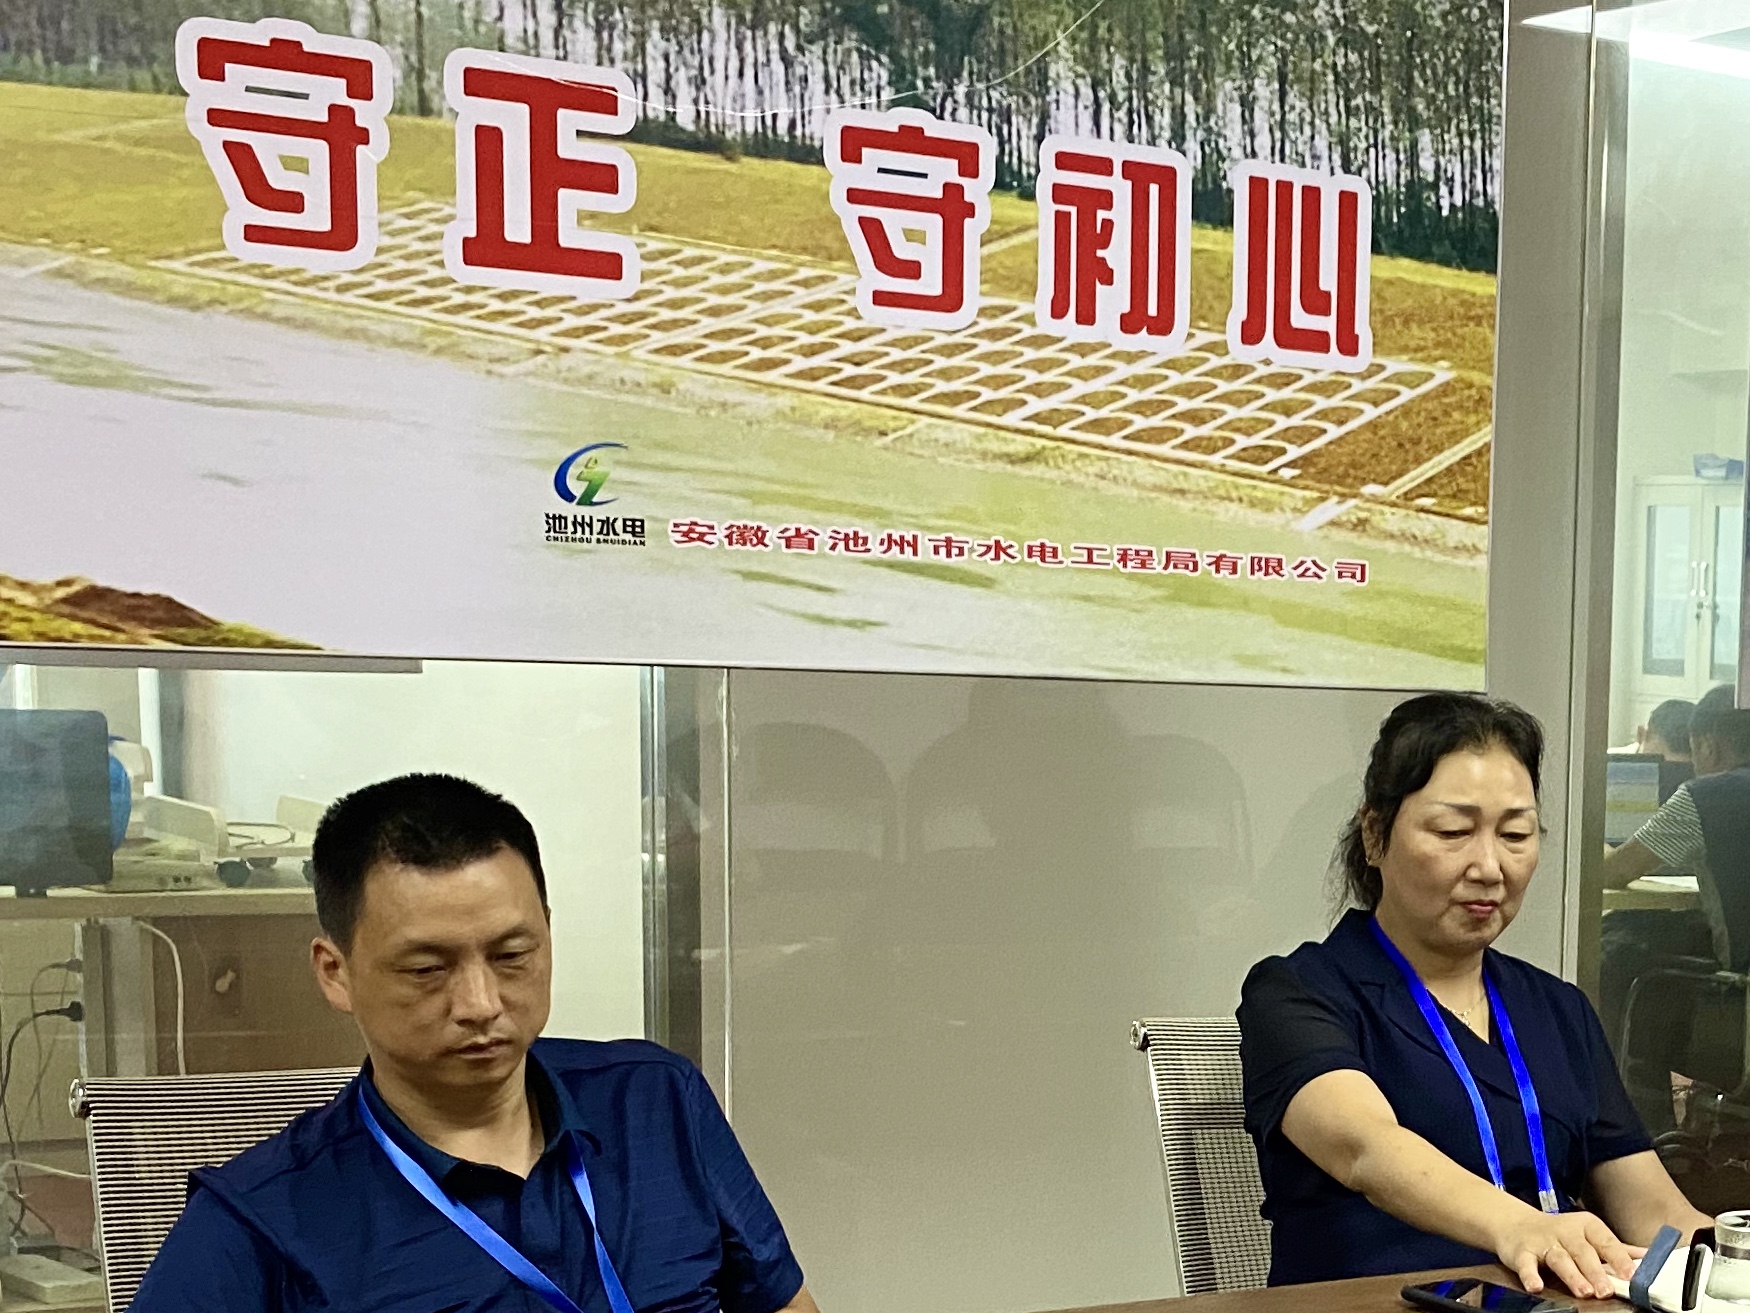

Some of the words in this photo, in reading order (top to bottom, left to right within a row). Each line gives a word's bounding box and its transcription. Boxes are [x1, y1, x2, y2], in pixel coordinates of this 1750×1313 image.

[186, 28, 632, 290] 守正
[833, 117, 1365, 364] 守初心
[544, 512, 645, 538] 池州水电
[545, 535, 592, 544] CHIZHOU
[596, 537, 646, 547] SHUIDIAN
[670, 519, 1370, 585] 安徽省池州市水电工程局有限公司
